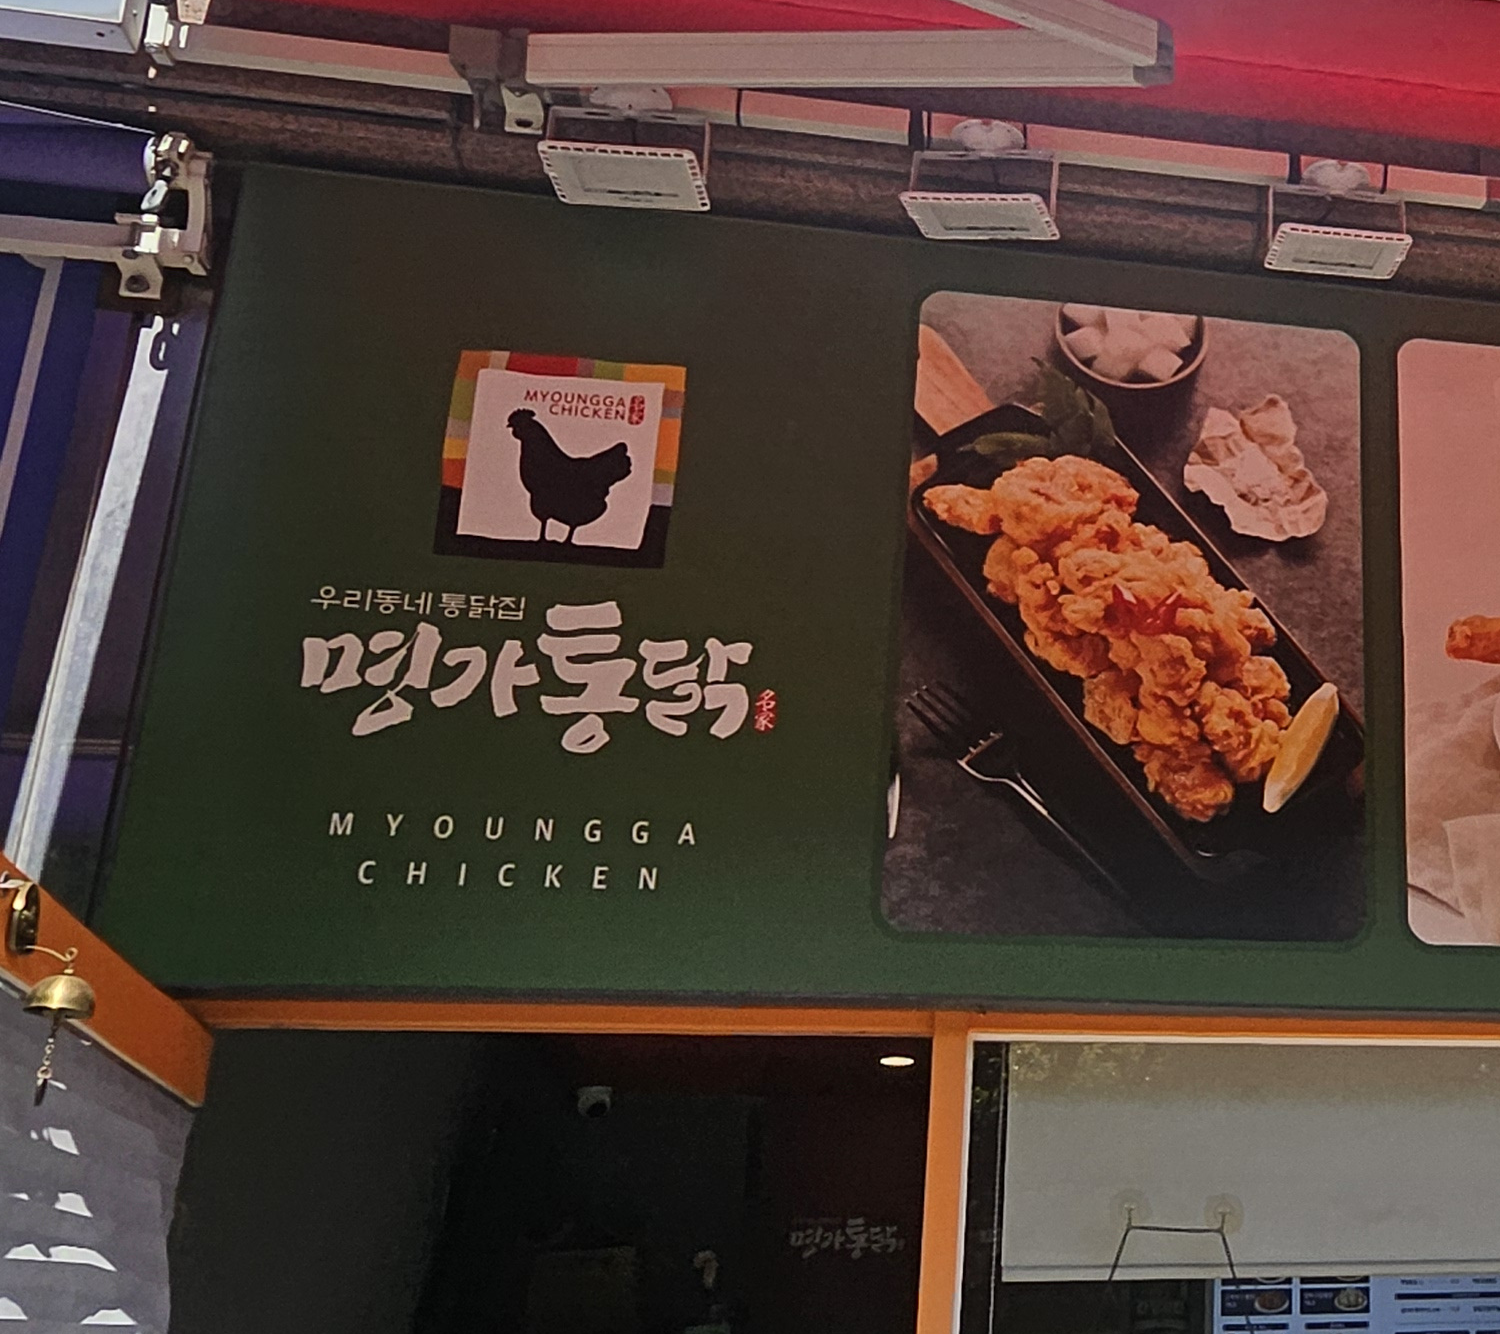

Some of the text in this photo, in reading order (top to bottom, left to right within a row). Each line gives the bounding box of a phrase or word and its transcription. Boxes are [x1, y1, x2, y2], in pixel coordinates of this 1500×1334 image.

[523, 388, 627, 411] MYOUNGGA
[548, 403, 627, 423] CHICKEN
[310, 585, 527, 621] 우리동네 통닭집
[300, 600, 754, 754] 명가통닭
[328, 811, 697, 846] MYOUNGGA
[357, 860, 660, 891] CHICKEN
